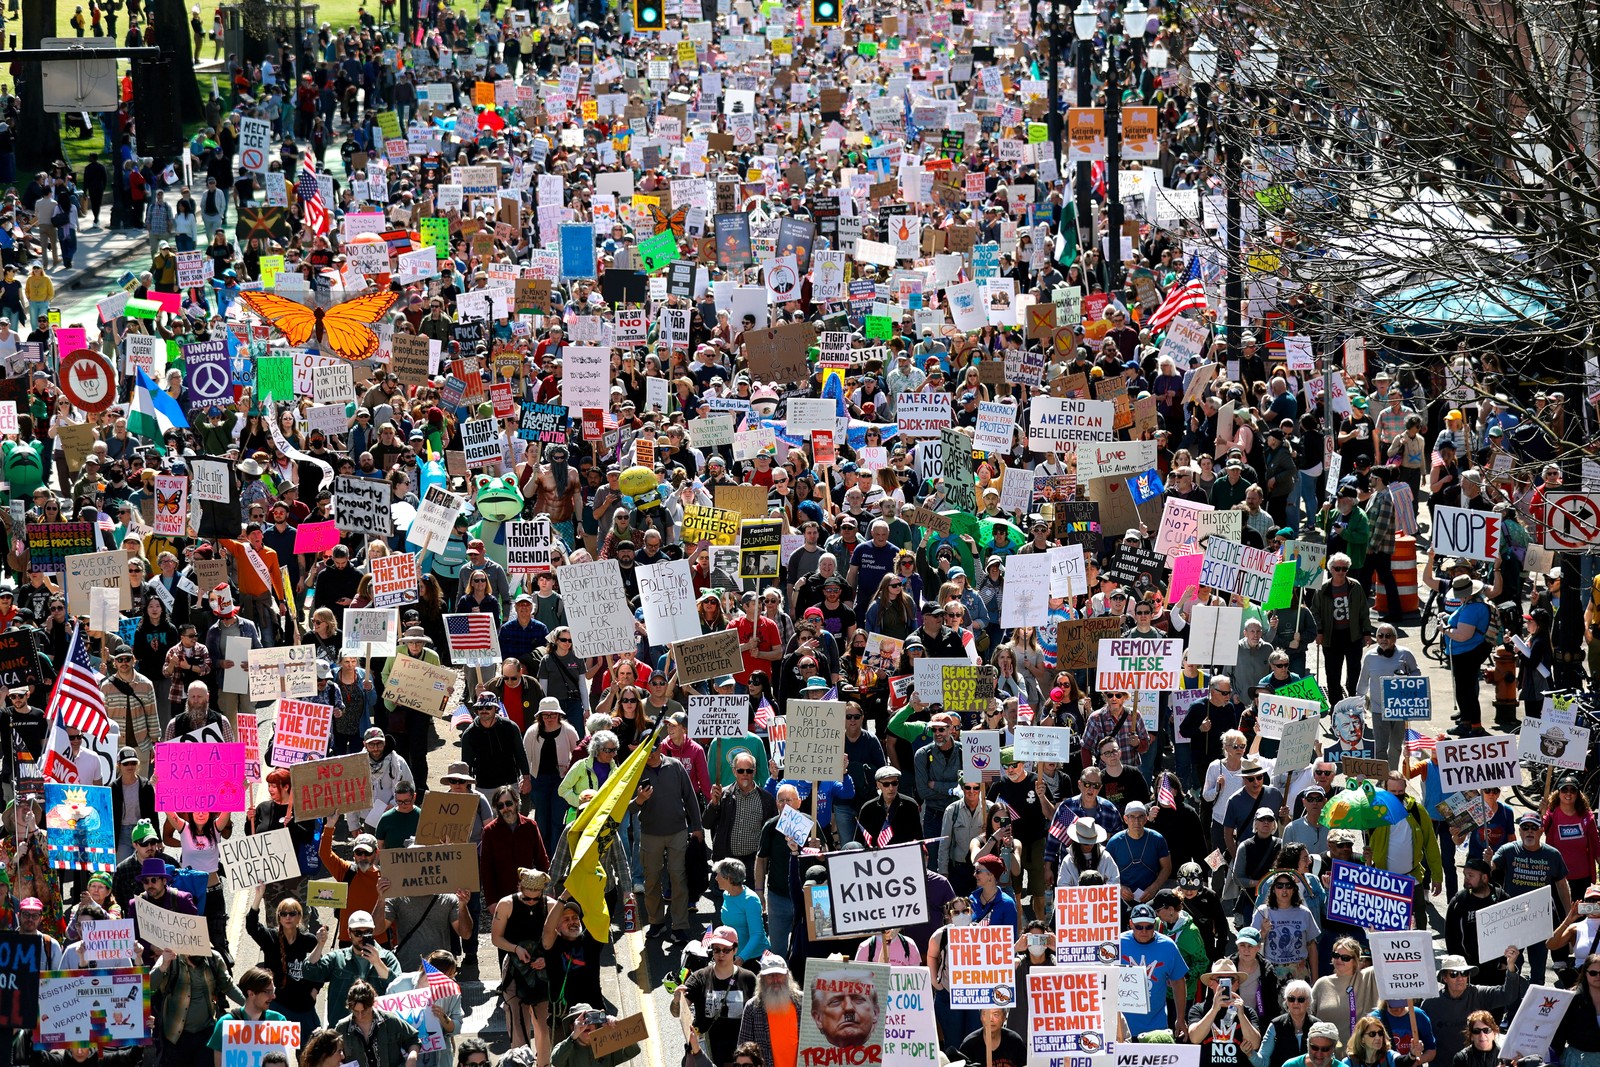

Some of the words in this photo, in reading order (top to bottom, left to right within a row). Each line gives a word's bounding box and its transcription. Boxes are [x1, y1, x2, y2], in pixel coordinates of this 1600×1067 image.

[244, 122, 268, 134] MELT
[1125, 126, 1154, 134] Saturday
[244, 134, 263, 146] ICE
[841, 218, 859, 226] OMG
[347, 246, 360, 256] NO
[363, 245, 386, 254] CROWN
[817, 252, 844, 262] QUIET
[352, 259, 380, 268] ORANGE
[814, 283, 840, 295] PIGGY!
[395, 337, 407, 345] TOO
[187, 343, 223, 353] UNPAID
[394, 347, 428, 356] PROBLEMS
[186, 353, 226, 364] PEACEFUL
[316, 367, 347, 376] JUSTICE
[394, 366, 427, 375] CARDBOARD
[317, 386, 351, 398] VICTIMS
[192, 397, 234, 408] PROTESTOR
[898, 394, 950, 405] AMERICA
[522, 403, 566, 415] MERMAIDS
[979, 403, 1015, 415] DEMOCRACY
[1061, 401, 1085, 412] END
[524, 412, 560, 422] AGAINST
[1000, 416, 1012, 424] FEAR
[1040, 414, 1102, 427] AMERICAN
[898, 419, 950, 430] DICK-TATOR
[980, 422, 1011, 434] PROTEST
[976, 434, 1001, 444] DICTATORS
[1002, 437, 1009, 445] DO
[1030, 428, 1112, 442] BELLIGERENCE
[197, 465, 210, 481] We
[212, 469, 223, 482] the
[195, 479, 223, 495] People
[335, 478, 383, 500] Liberty
[374, 504, 388, 514] NO
[512, 522, 543, 536] FIGHT
[508, 535, 549, 547] TRUMP'S
[743, 535, 779, 545] DUMMIES
[509, 550, 549, 564] AGENDA
[1207, 538, 1241, 560] REGIME
[1241, 546, 1275, 574] CHANGE
[1141, 559, 1158, 568] ACCEPT
[560, 565, 596, 579] ABOLISH
[600, 563, 617, 575] TAX
[564, 576, 618, 591] EXEMPTIONS
[1120, 573, 1135, 582] RESIST
[1200, 560, 1236, 591] BEGINS
[1235, 570, 1246, 593] AT
[1246, 574, 1271, 602] HOME
[563, 594, 578, 604] FOR
[582, 588, 625, 602] CHURCHES
[568, 606, 590, 619] THAT
[593, 603, 619, 616] LOBBY
[591, 616, 610, 628] FOR
[578, 628, 628, 643] CHRISTIAN
[575, 640, 636, 656] NATIONALISM
[1111, 640, 1172, 656] REMOVE
[1119, 657, 1164, 670] THESE
[1100, 672, 1174, 689] LUNATICS!
[1390, 679, 1424, 689] STOP
[690, 696, 716, 707] STOP
[718, 696, 748, 706] TRUMP
[1388, 698, 1429, 708] FASCIST
[796, 706, 819, 717] NOT
[826, 708, 835, 717] A
[1384, 708, 1429, 718] BULLSHIT
[803, 718, 826, 727] PAID
[694, 726, 743, 736] AMERICA
[789, 727, 840, 739] PROTESTER
[793, 742, 799, 752] I
[806, 743, 839, 755] FIGHT
[1445, 741, 1509, 762] RESIST
[789, 755, 833, 764] FACISM
[1328, 750, 1370, 762] NOPE
[318, 763, 344, 779] NO
[789, 766, 807, 774] FOR
[1443, 761, 1516, 785] TYRANNY
[302, 778, 370, 810] APATHY
[223, 833, 271, 864] EVOLVE
[390, 850, 462, 864] IMMIGRANTS
[231, 854, 288, 890] ALREADY
[421, 864, 441, 875] ARE
[854, 857, 895, 878] NO
[1512, 862, 1529, 870] drink
[1531, 863, 1550, 871] coffee
[1514, 867, 1546, 876] dismantle
[402, 876, 448, 887] AMERICA
[1339, 865, 1408, 894] PROUDLY
[1513, 873, 1537, 882] systems
[841, 876, 917, 903] KINGS
[1334, 887, 1406, 915] DEFENDING
[843, 908, 886, 923] SINCE
[892, 903, 920, 919] 1776
[1331, 902, 1408, 929] DEMOCRACY
[950, 929, 1012, 943] REVOKE
[1391, 940, 1410, 949] NO
[950, 946, 984, 966] THE
[985, 944, 1012, 964] ICE
[1384, 951, 1422, 961] WARS
[953, 970, 1013, 985] PERMIT!
[1392, 973, 1418, 981] STOP
[816, 978, 874, 995] RAPIST
[1389, 981, 1425, 989] TRUMP
[953, 989, 964, 997] ICE
[800, 1044, 882, 1066] TRAITOR
[1211, 1043, 1237, 1055] NO
[1212, 1056, 1238, 1064] KINGS
